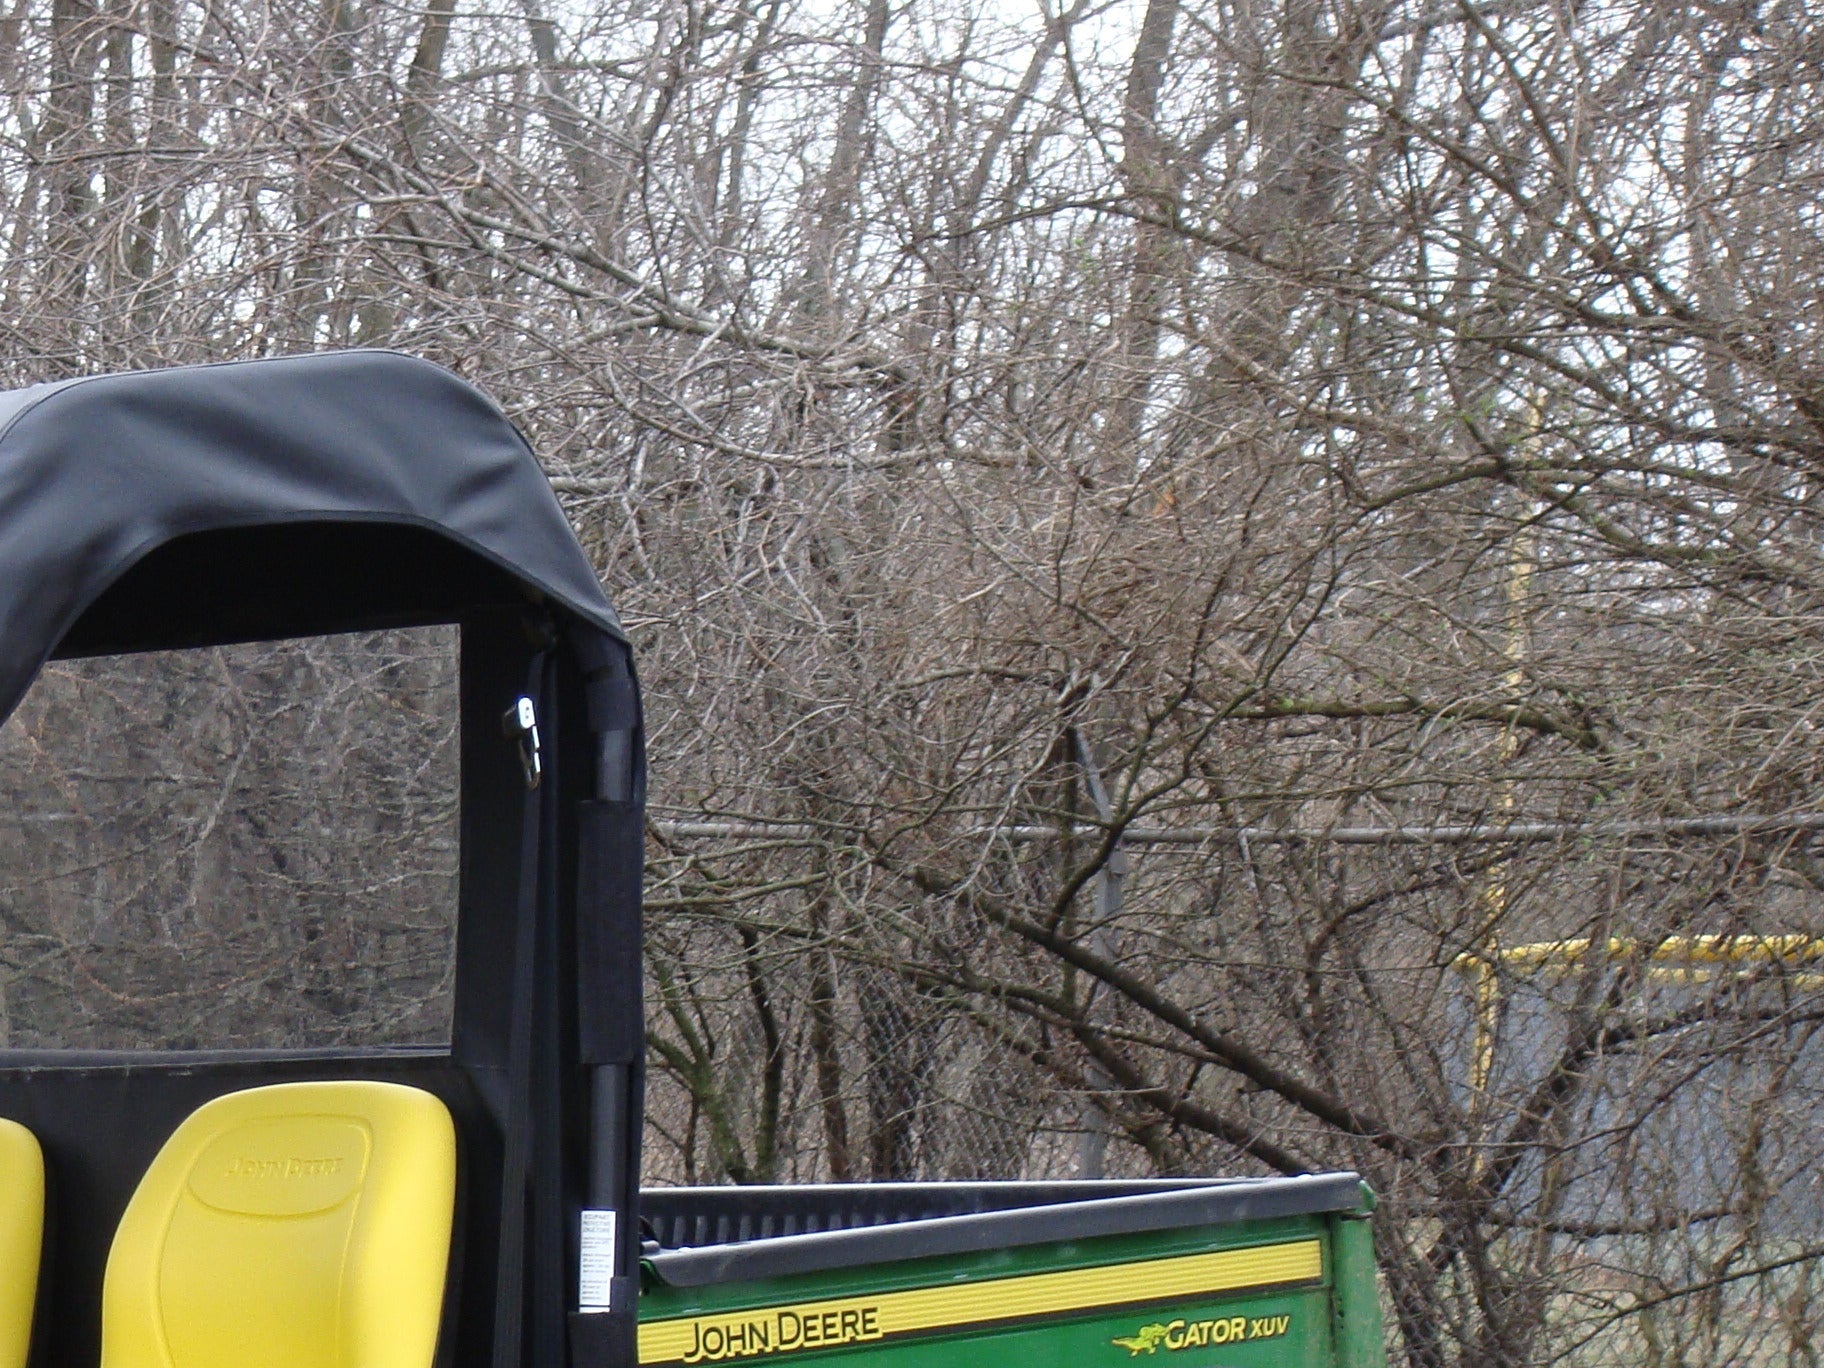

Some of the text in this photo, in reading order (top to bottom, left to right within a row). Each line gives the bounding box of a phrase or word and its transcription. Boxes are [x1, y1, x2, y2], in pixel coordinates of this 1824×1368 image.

[683, 1306, 880, 1360] JOHN DEERE
[1163, 1314, 1290, 1350] GATOR XUV
